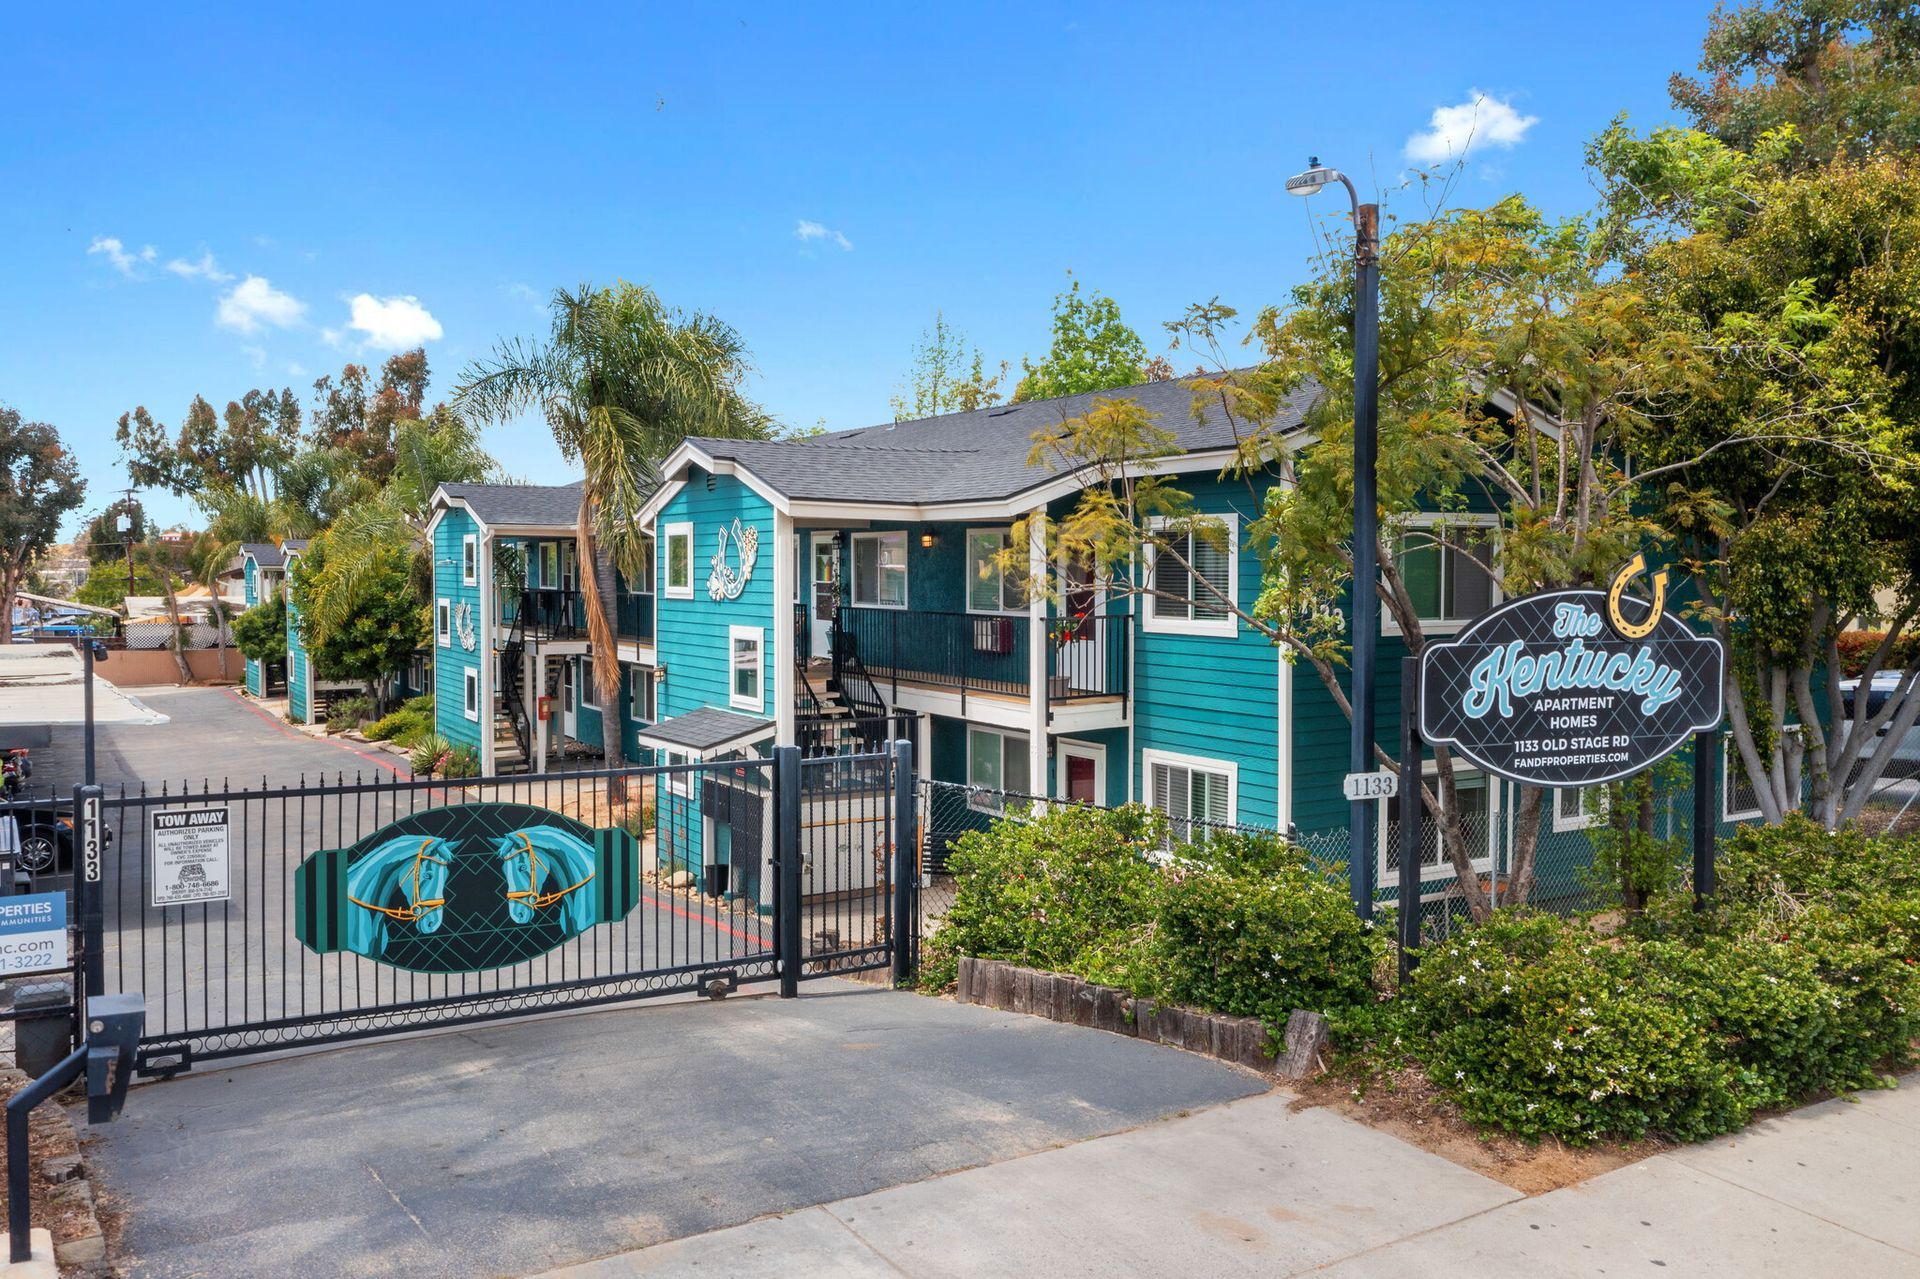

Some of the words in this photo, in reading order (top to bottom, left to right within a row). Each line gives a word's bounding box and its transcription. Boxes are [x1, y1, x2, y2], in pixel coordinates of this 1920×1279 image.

[1553, 602, 1602, 638] The
[1462, 638, 1682, 719] Kentucky
[1534, 696, 1615, 712] APARTMENT
[1550, 715, 1597, 729] HOMES
[1514, 740, 1539, 753] 1133
[1542, 738, 1568, 751] OLD
[1570, 736, 1610, 749] STAGE
[1612, 735, 1630, 747] RD
[1514, 752, 1629, 769] FANDFPROPERTIES.COM
[1353, 776, 1393, 797] 1133
[157, 814, 186, 827] TOW
[188, 811, 225, 825] AWAY
[86, 799, 98, 881] 1133
[157, 828, 196, 837] AUTHORIZED
[197, 826, 224, 834] PARKING
[0, 901, 52, 917] PERTIES
[0, 940, 54, 955] c.com
[1, 953, 52, 970] 1-3222
